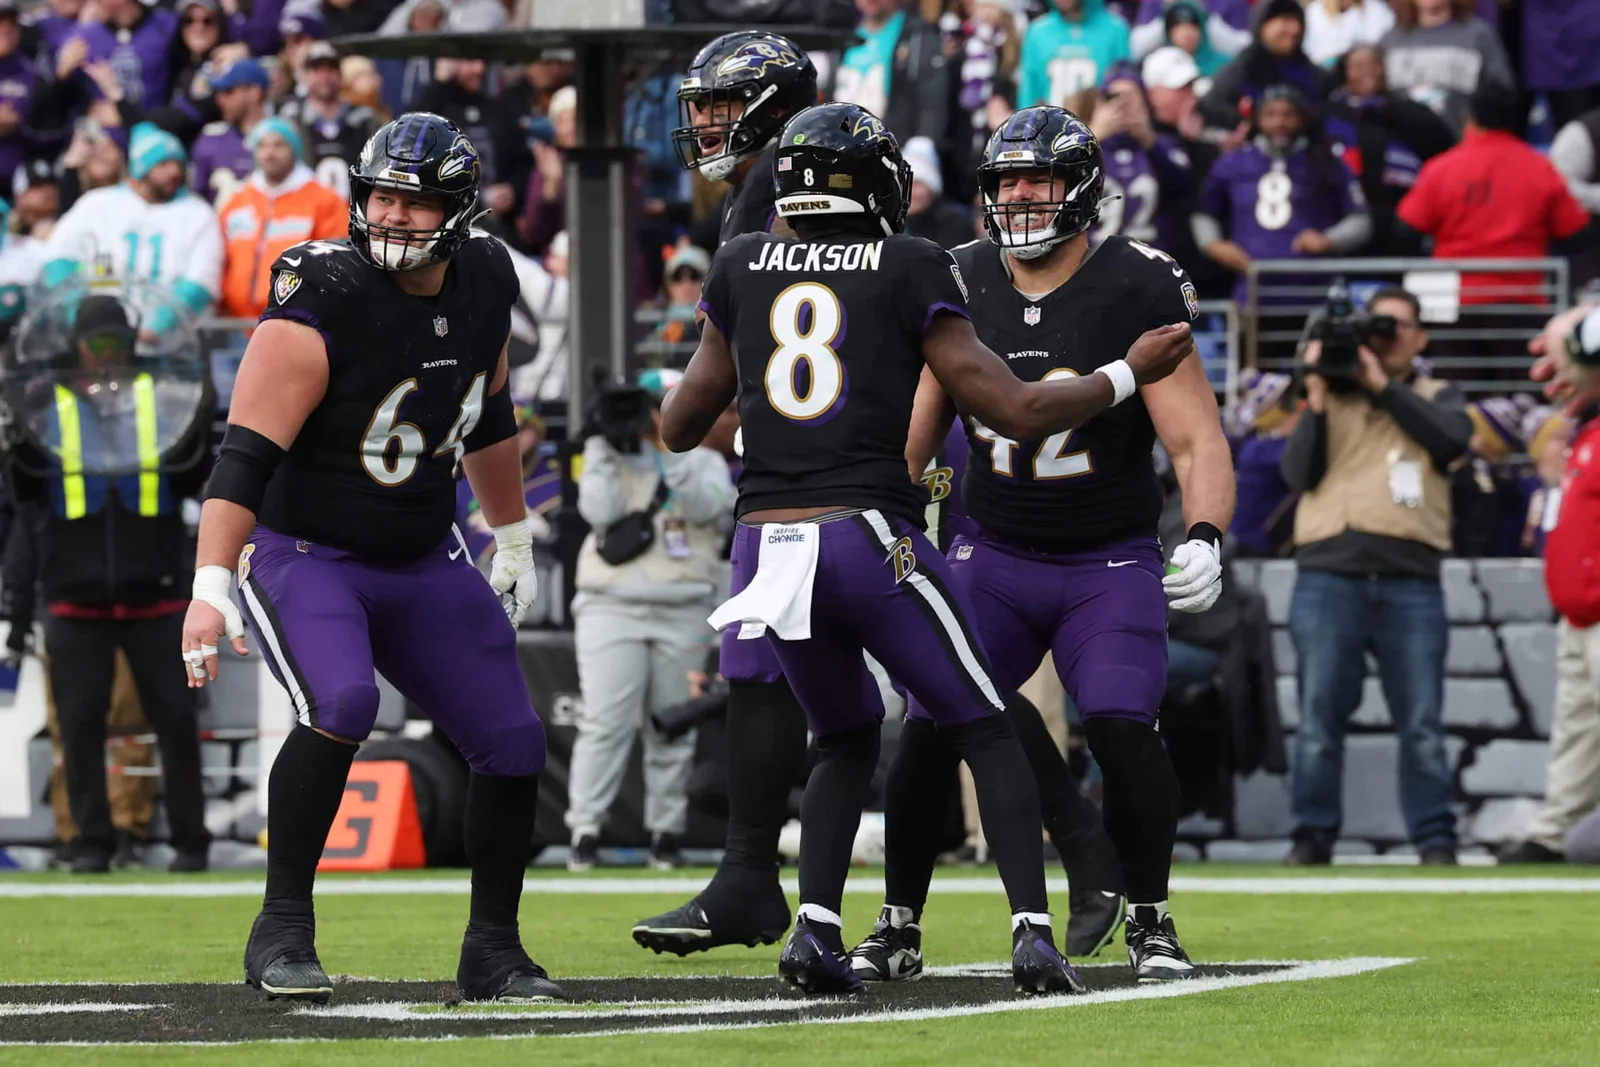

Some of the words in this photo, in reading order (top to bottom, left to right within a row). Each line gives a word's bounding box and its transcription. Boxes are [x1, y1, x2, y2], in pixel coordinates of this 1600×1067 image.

[803, 168, 815, 187] 8
[780, 200, 831, 213] RAVENS
[1255, 170, 1292, 230] 8
[123, 231, 163, 280] 11
[748, 240, 884, 272] JACKSON
[421, 358, 458, 369] RAVENS
[764, 281, 848, 427] 8
[1007, 350, 1049, 360] RAVENS
[360, 370, 488, 487] 64
[920, 466, 954, 503] B
[768, 534, 805, 544] CHANGE
[883, 536, 916, 584] B
[321, 780, 379, 859] G
